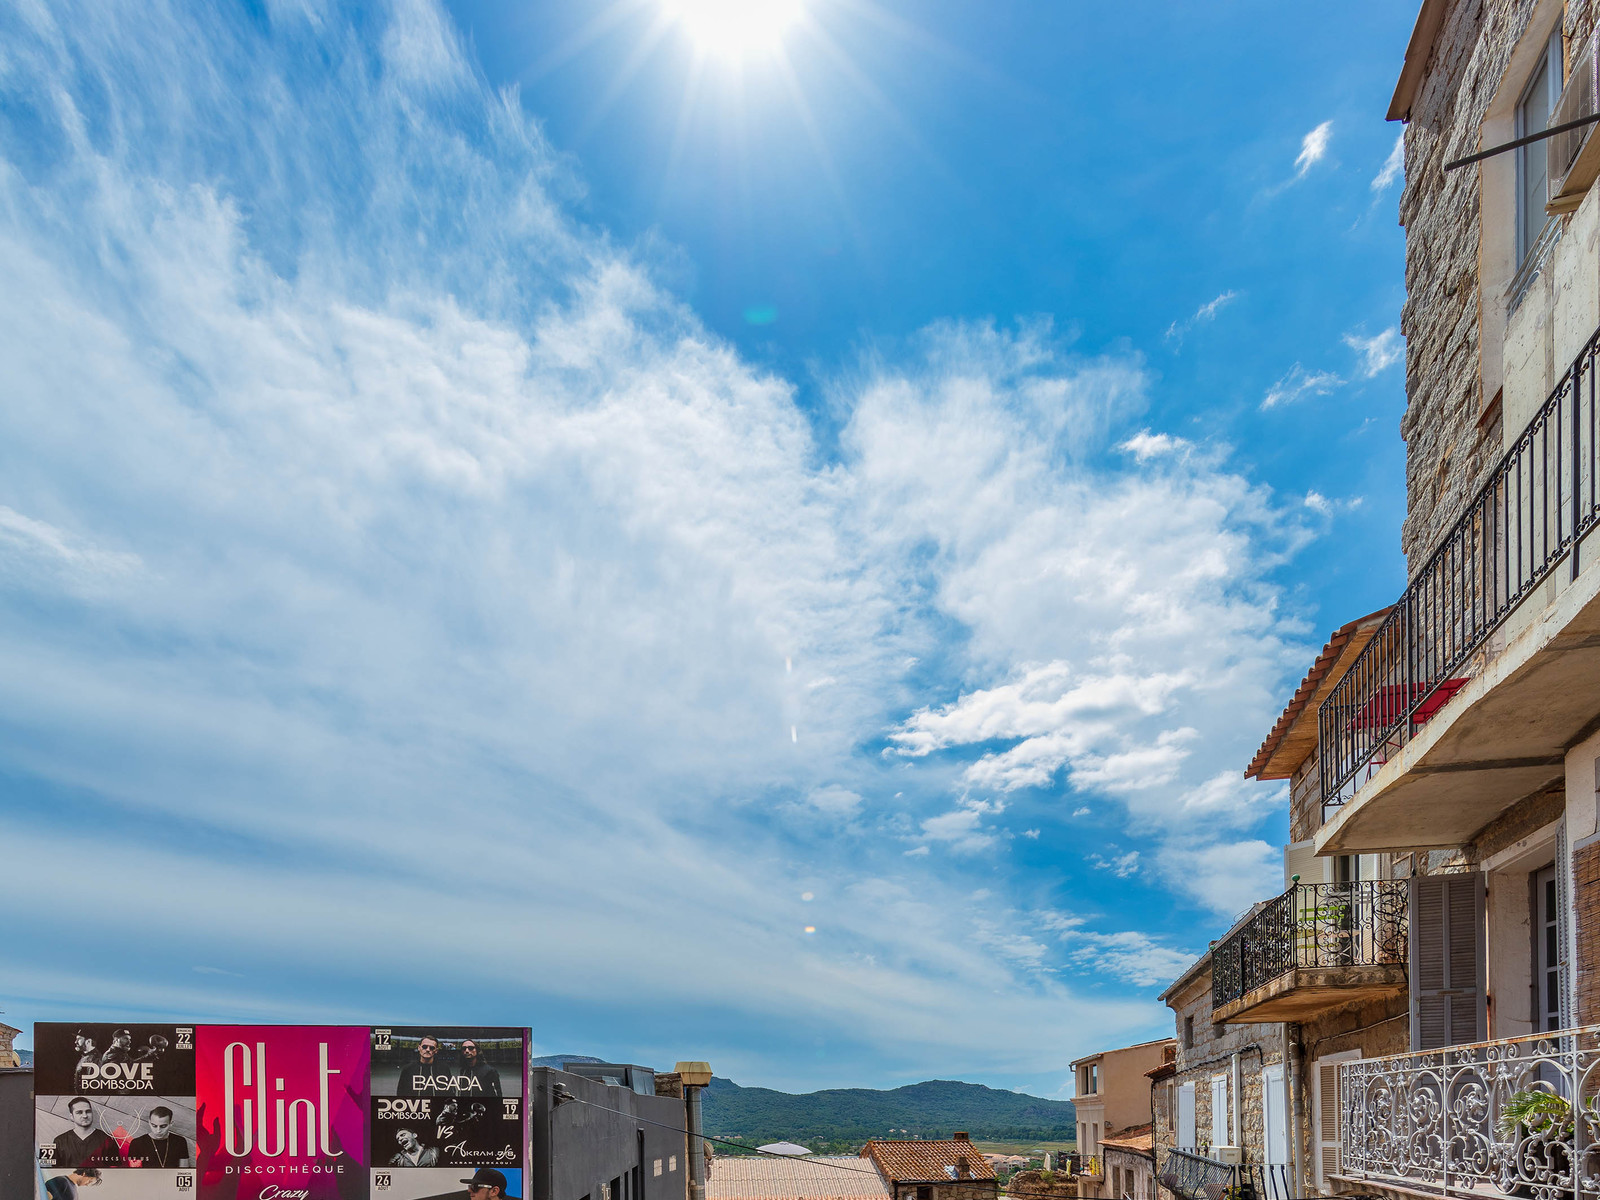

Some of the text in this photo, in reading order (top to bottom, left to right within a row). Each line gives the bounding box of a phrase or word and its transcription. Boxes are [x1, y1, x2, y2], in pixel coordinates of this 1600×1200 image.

[178, 1034, 190, 1043] 22
[377, 1035, 389, 1045] 12
[82, 1063, 153, 1080] DOVE
[82, 1079, 153, 1090] BOMBSODA
[412, 1075, 482, 1091] BASADA
[378, 1099, 431, 1112] DOVE
[505, 1105, 516, 1114] 19
[378, 1112, 431, 1120] BOMBSODA
[436, 1126, 454, 1139] VS
[41, 1149, 54, 1159] 29
[225, 1163, 344, 1174] DISCOTHÈQUE
[178, 1177, 190, 1187] 05
[377, 1176, 389, 1185] 26
